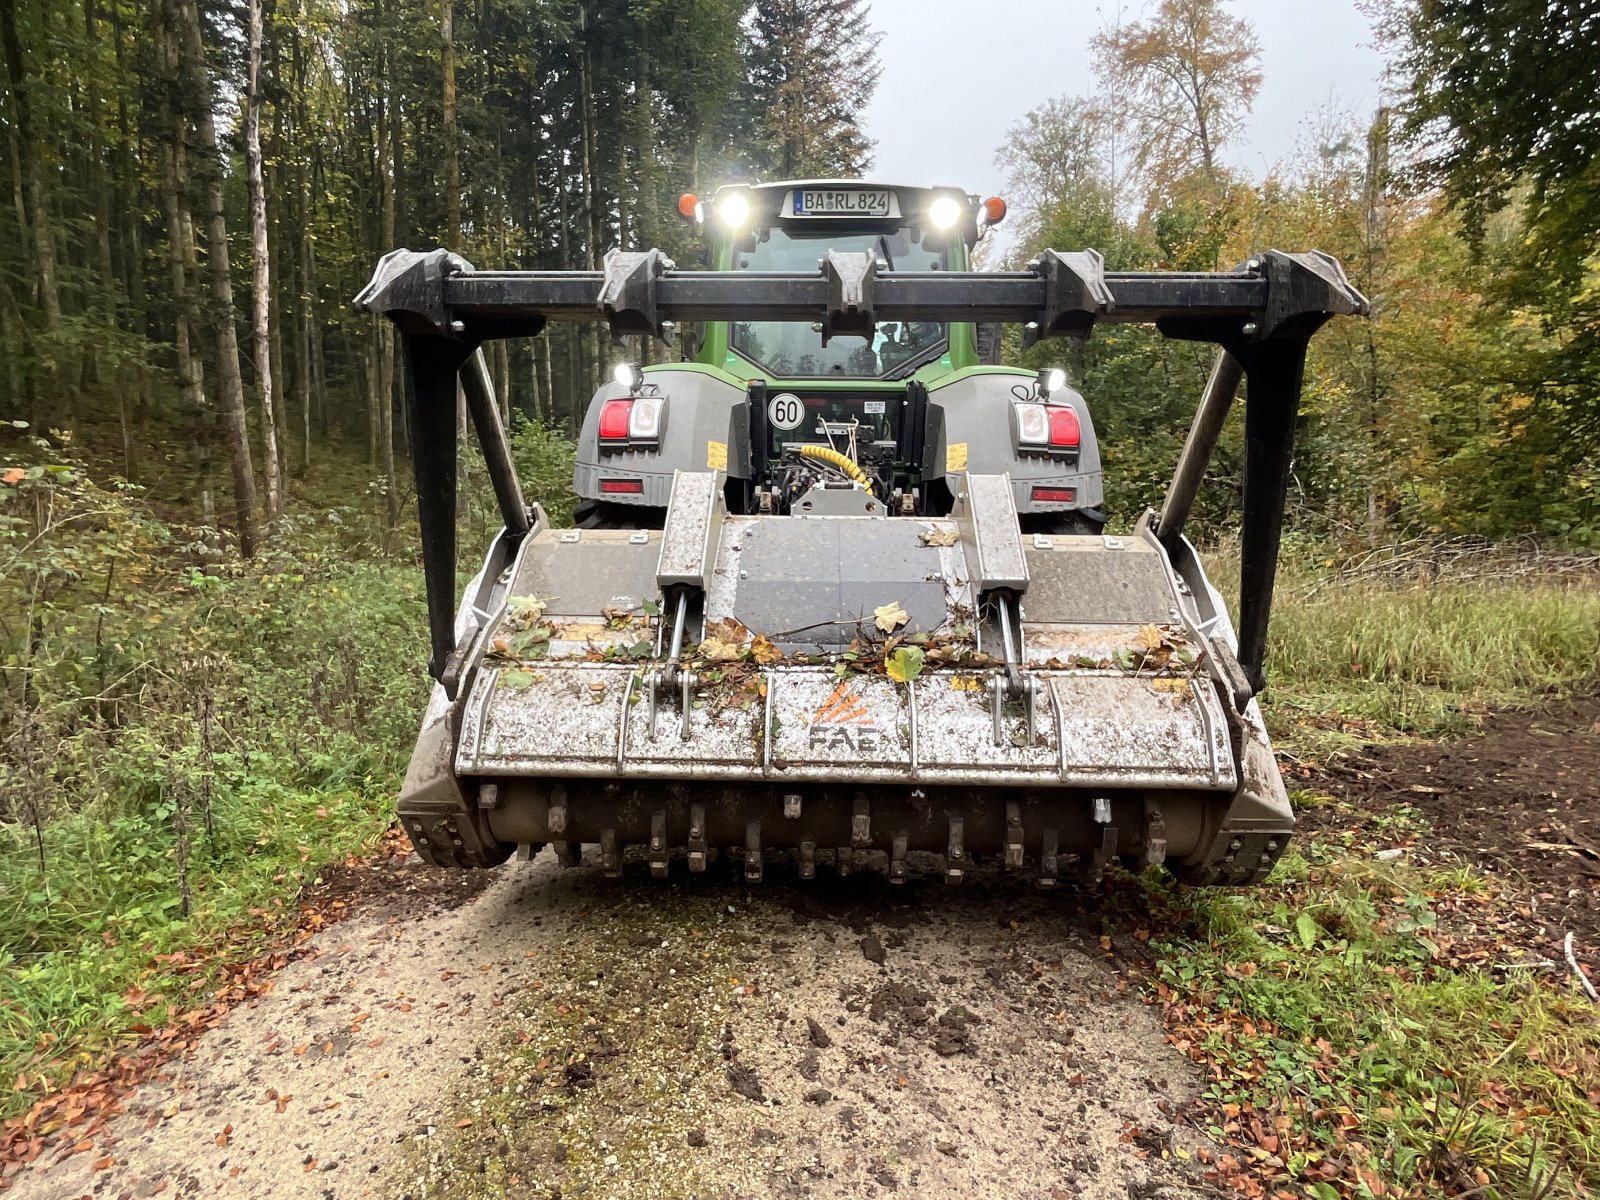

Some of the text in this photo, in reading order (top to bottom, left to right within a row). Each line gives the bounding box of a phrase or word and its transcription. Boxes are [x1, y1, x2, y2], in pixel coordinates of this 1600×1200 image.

[804, 193, 886, 210] BA RL 824
[775, 400, 797, 423] 60
[809, 726, 878, 752] FAE
